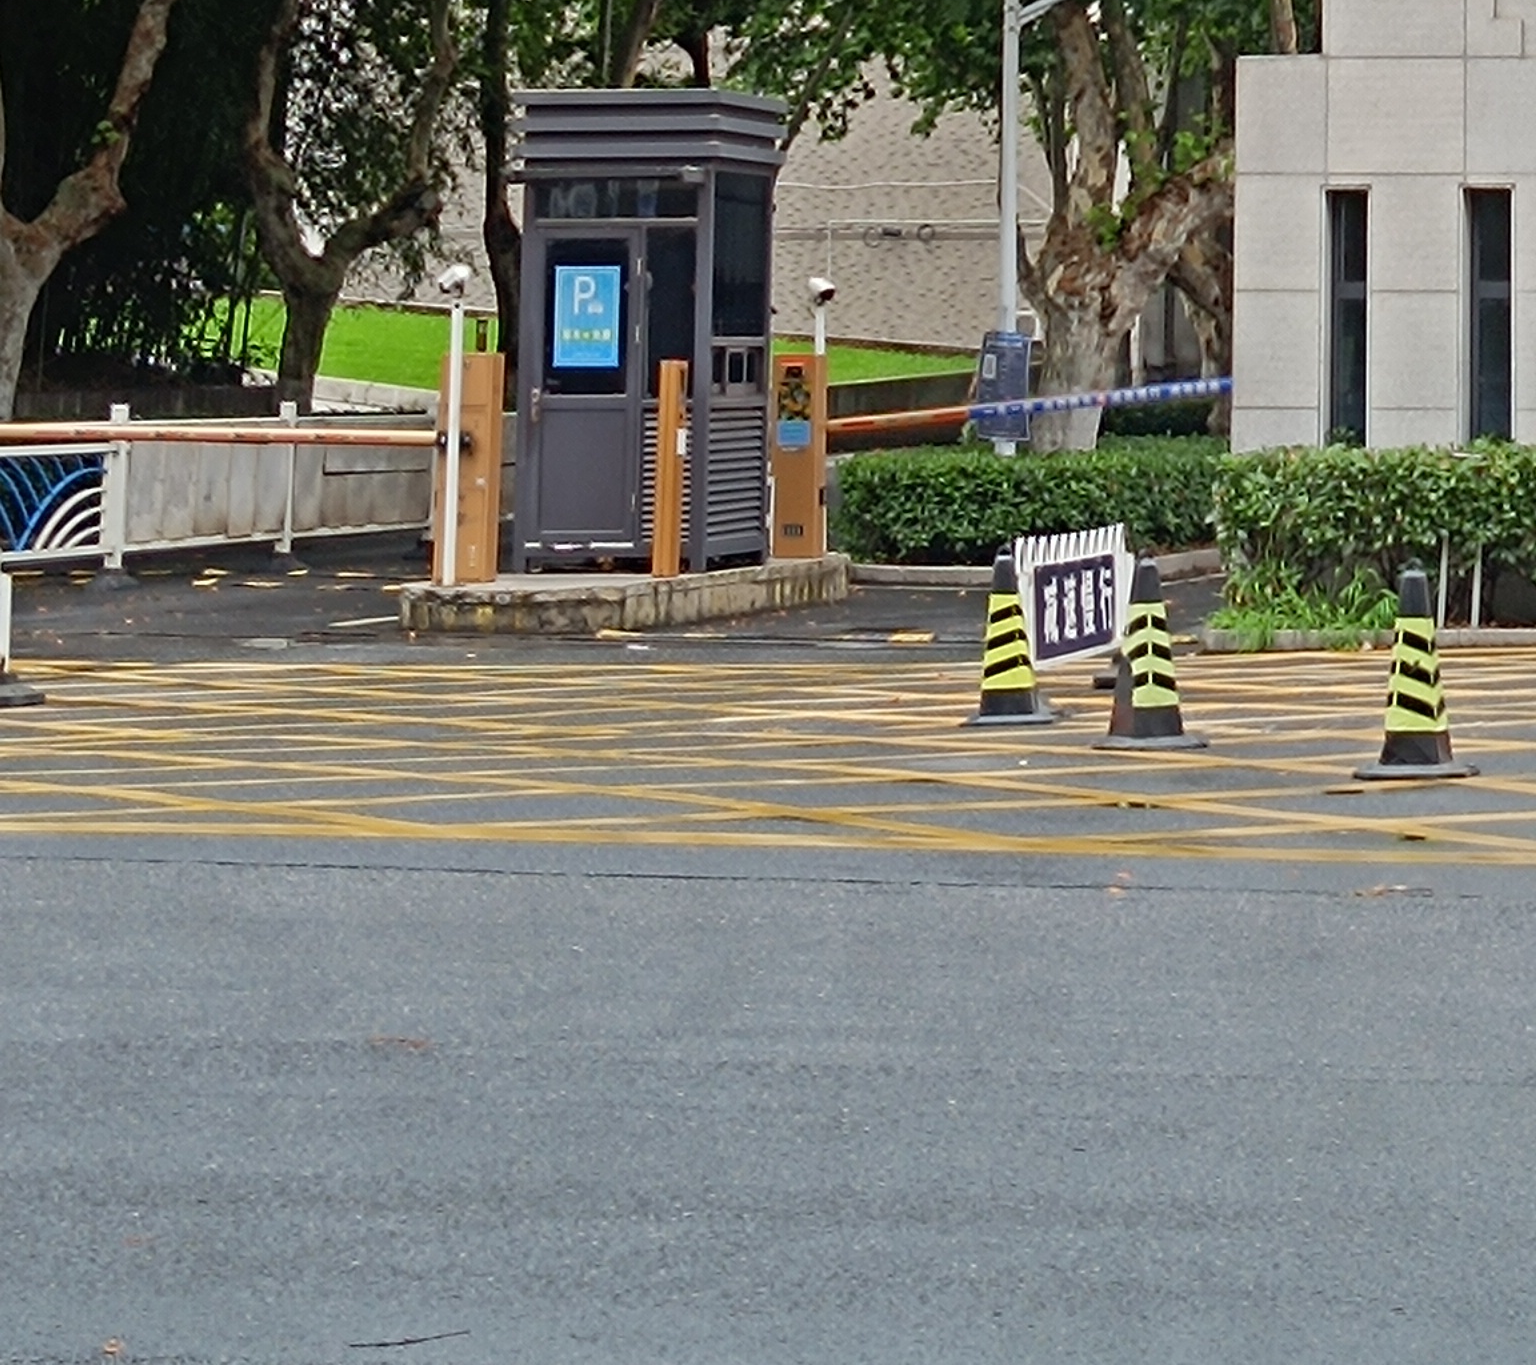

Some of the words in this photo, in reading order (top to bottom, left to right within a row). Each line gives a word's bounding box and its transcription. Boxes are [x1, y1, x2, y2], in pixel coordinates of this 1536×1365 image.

[574, 275, 596, 315] P
[1043, 567, 1113, 644] 减速慢行
